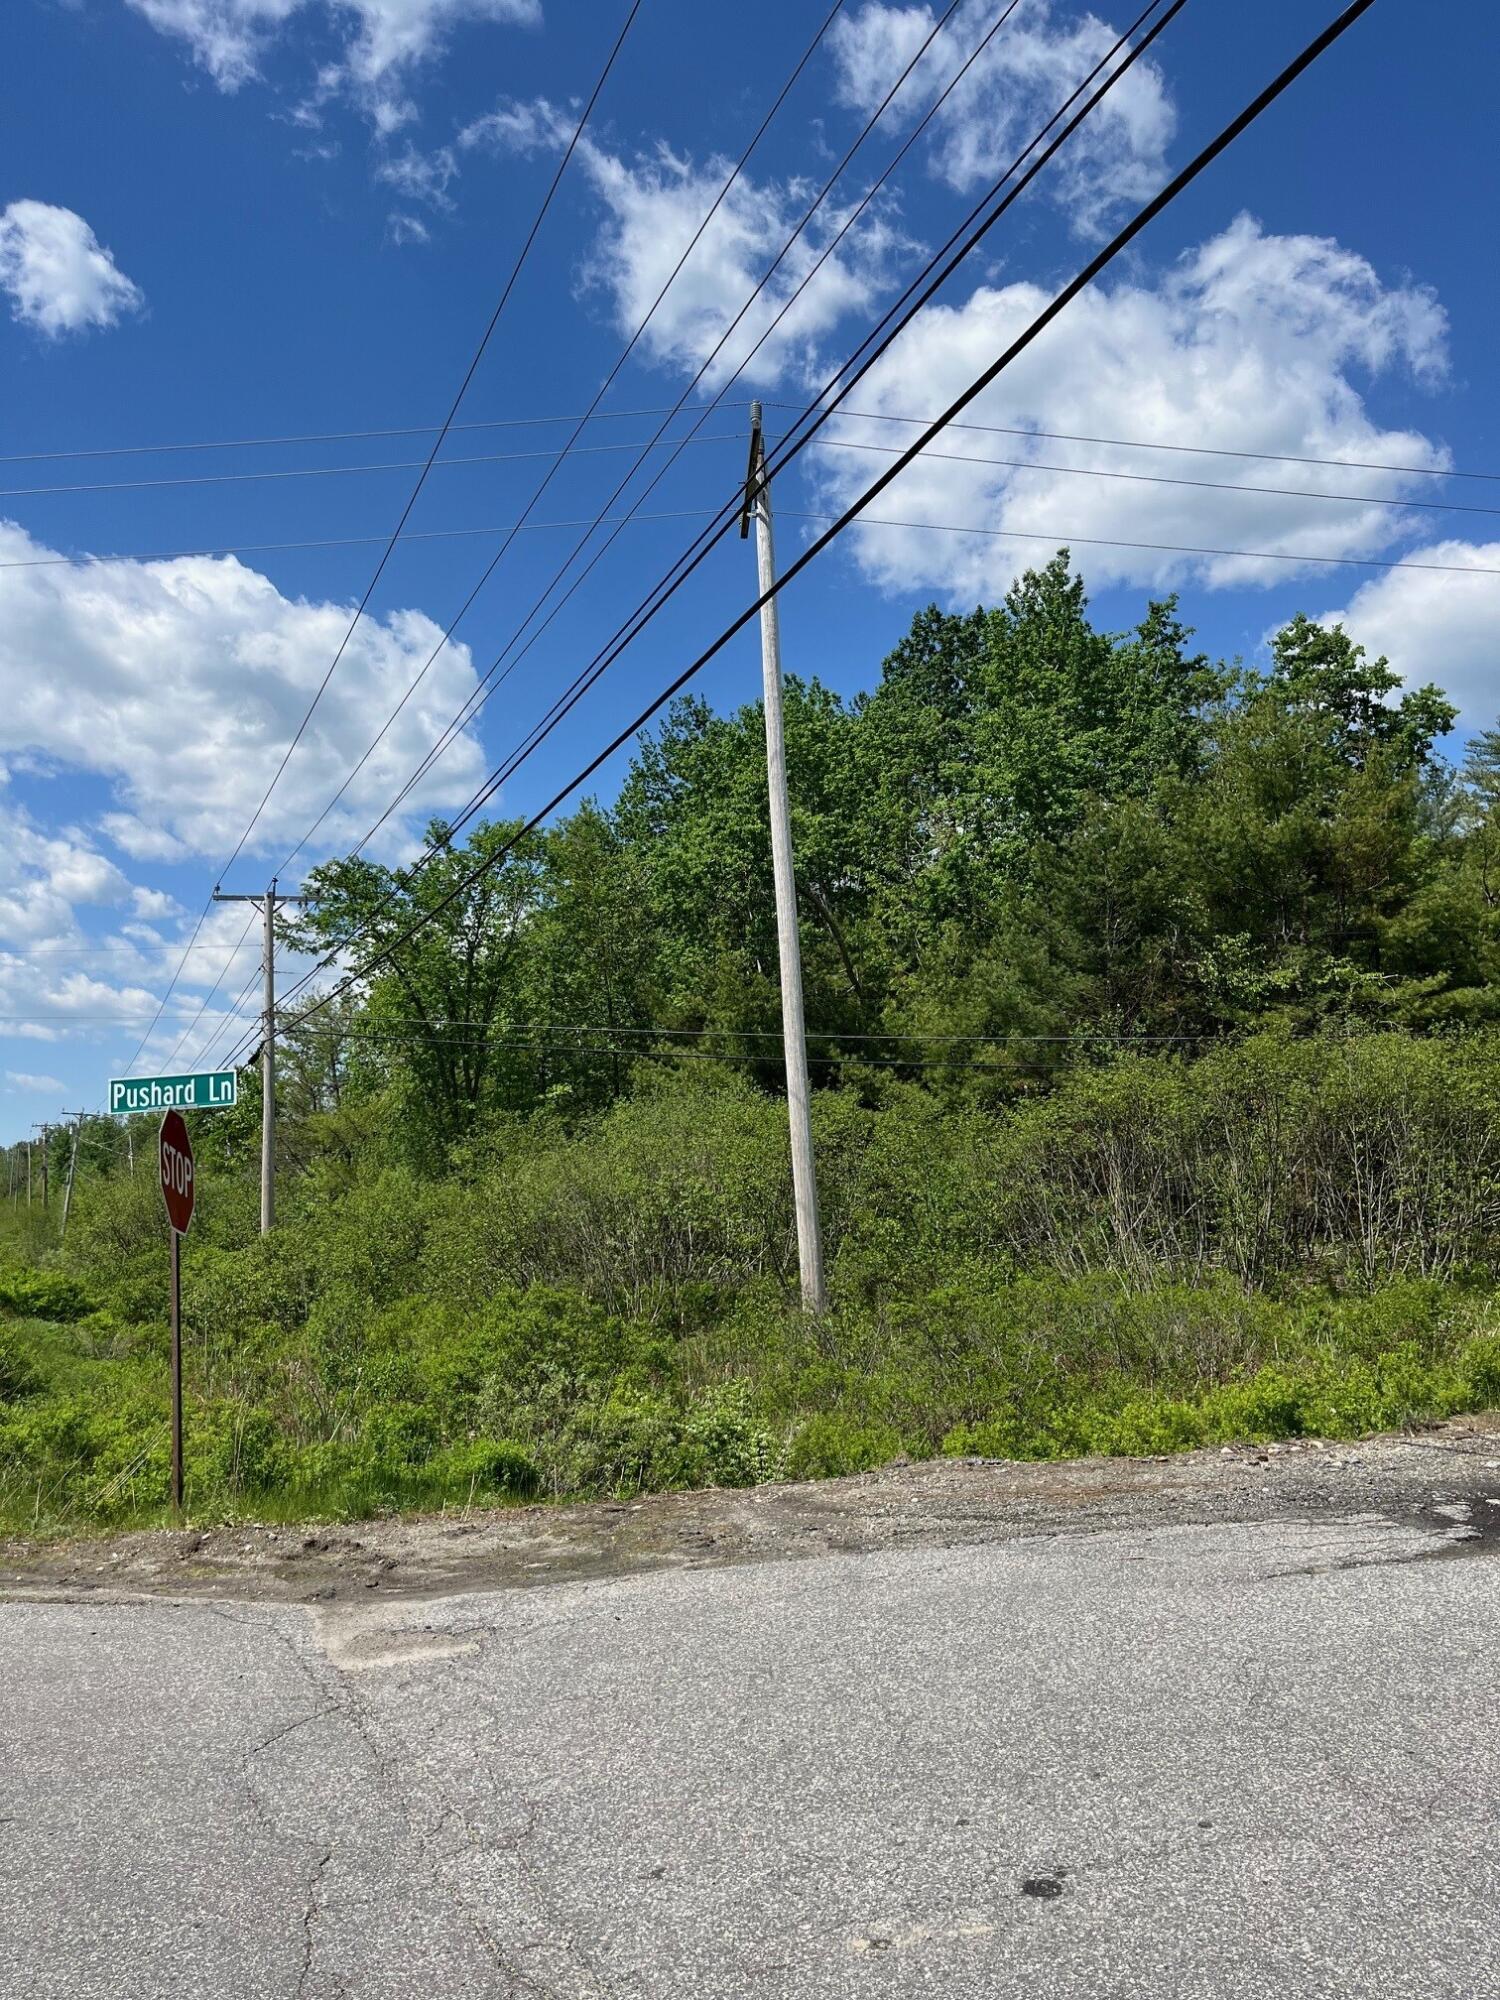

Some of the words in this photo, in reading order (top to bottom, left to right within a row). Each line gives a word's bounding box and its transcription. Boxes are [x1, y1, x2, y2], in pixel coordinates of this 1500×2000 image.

[113, 1078, 195, 1108] Pushard
[209, 1076, 232, 1101] Ln
[163, 1141, 192, 1198] STOP
